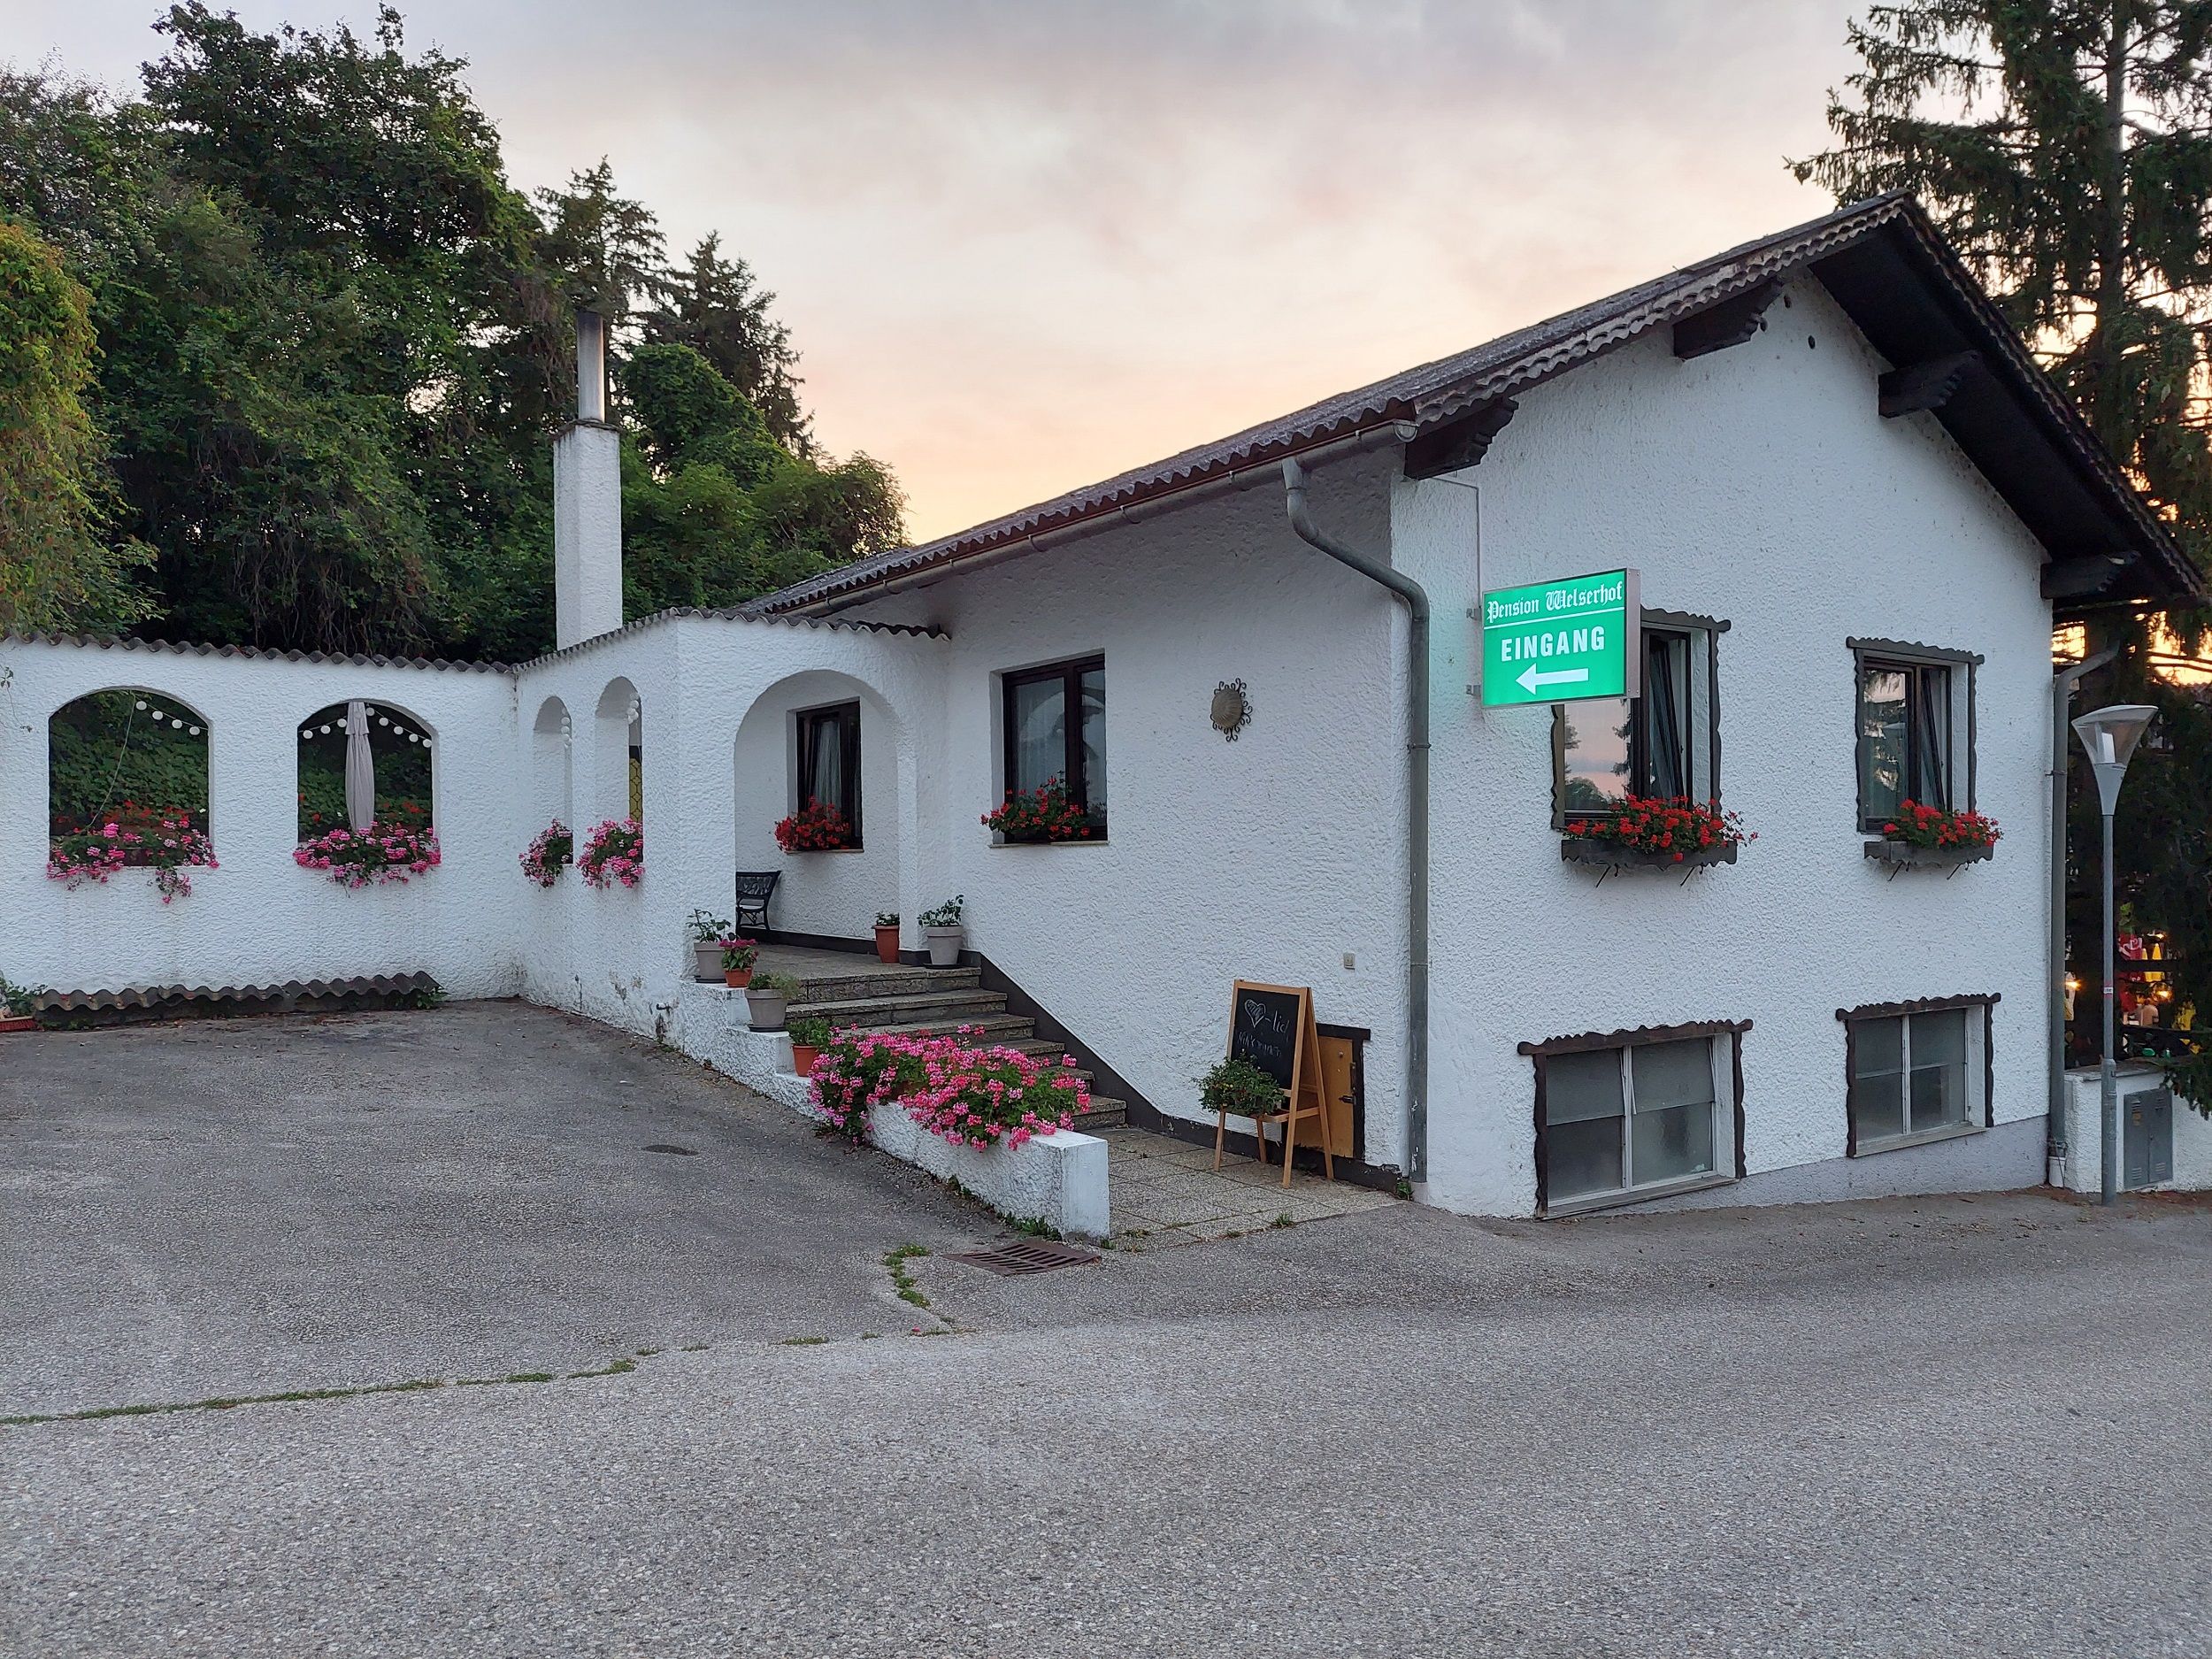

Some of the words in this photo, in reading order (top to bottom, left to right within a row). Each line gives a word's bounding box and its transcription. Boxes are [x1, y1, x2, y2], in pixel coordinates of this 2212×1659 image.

[1486, 597, 1540, 623] Pension
[1546, 580, 1623, 611] Welserhof
[1501, 626, 1605, 662] EINGANG
